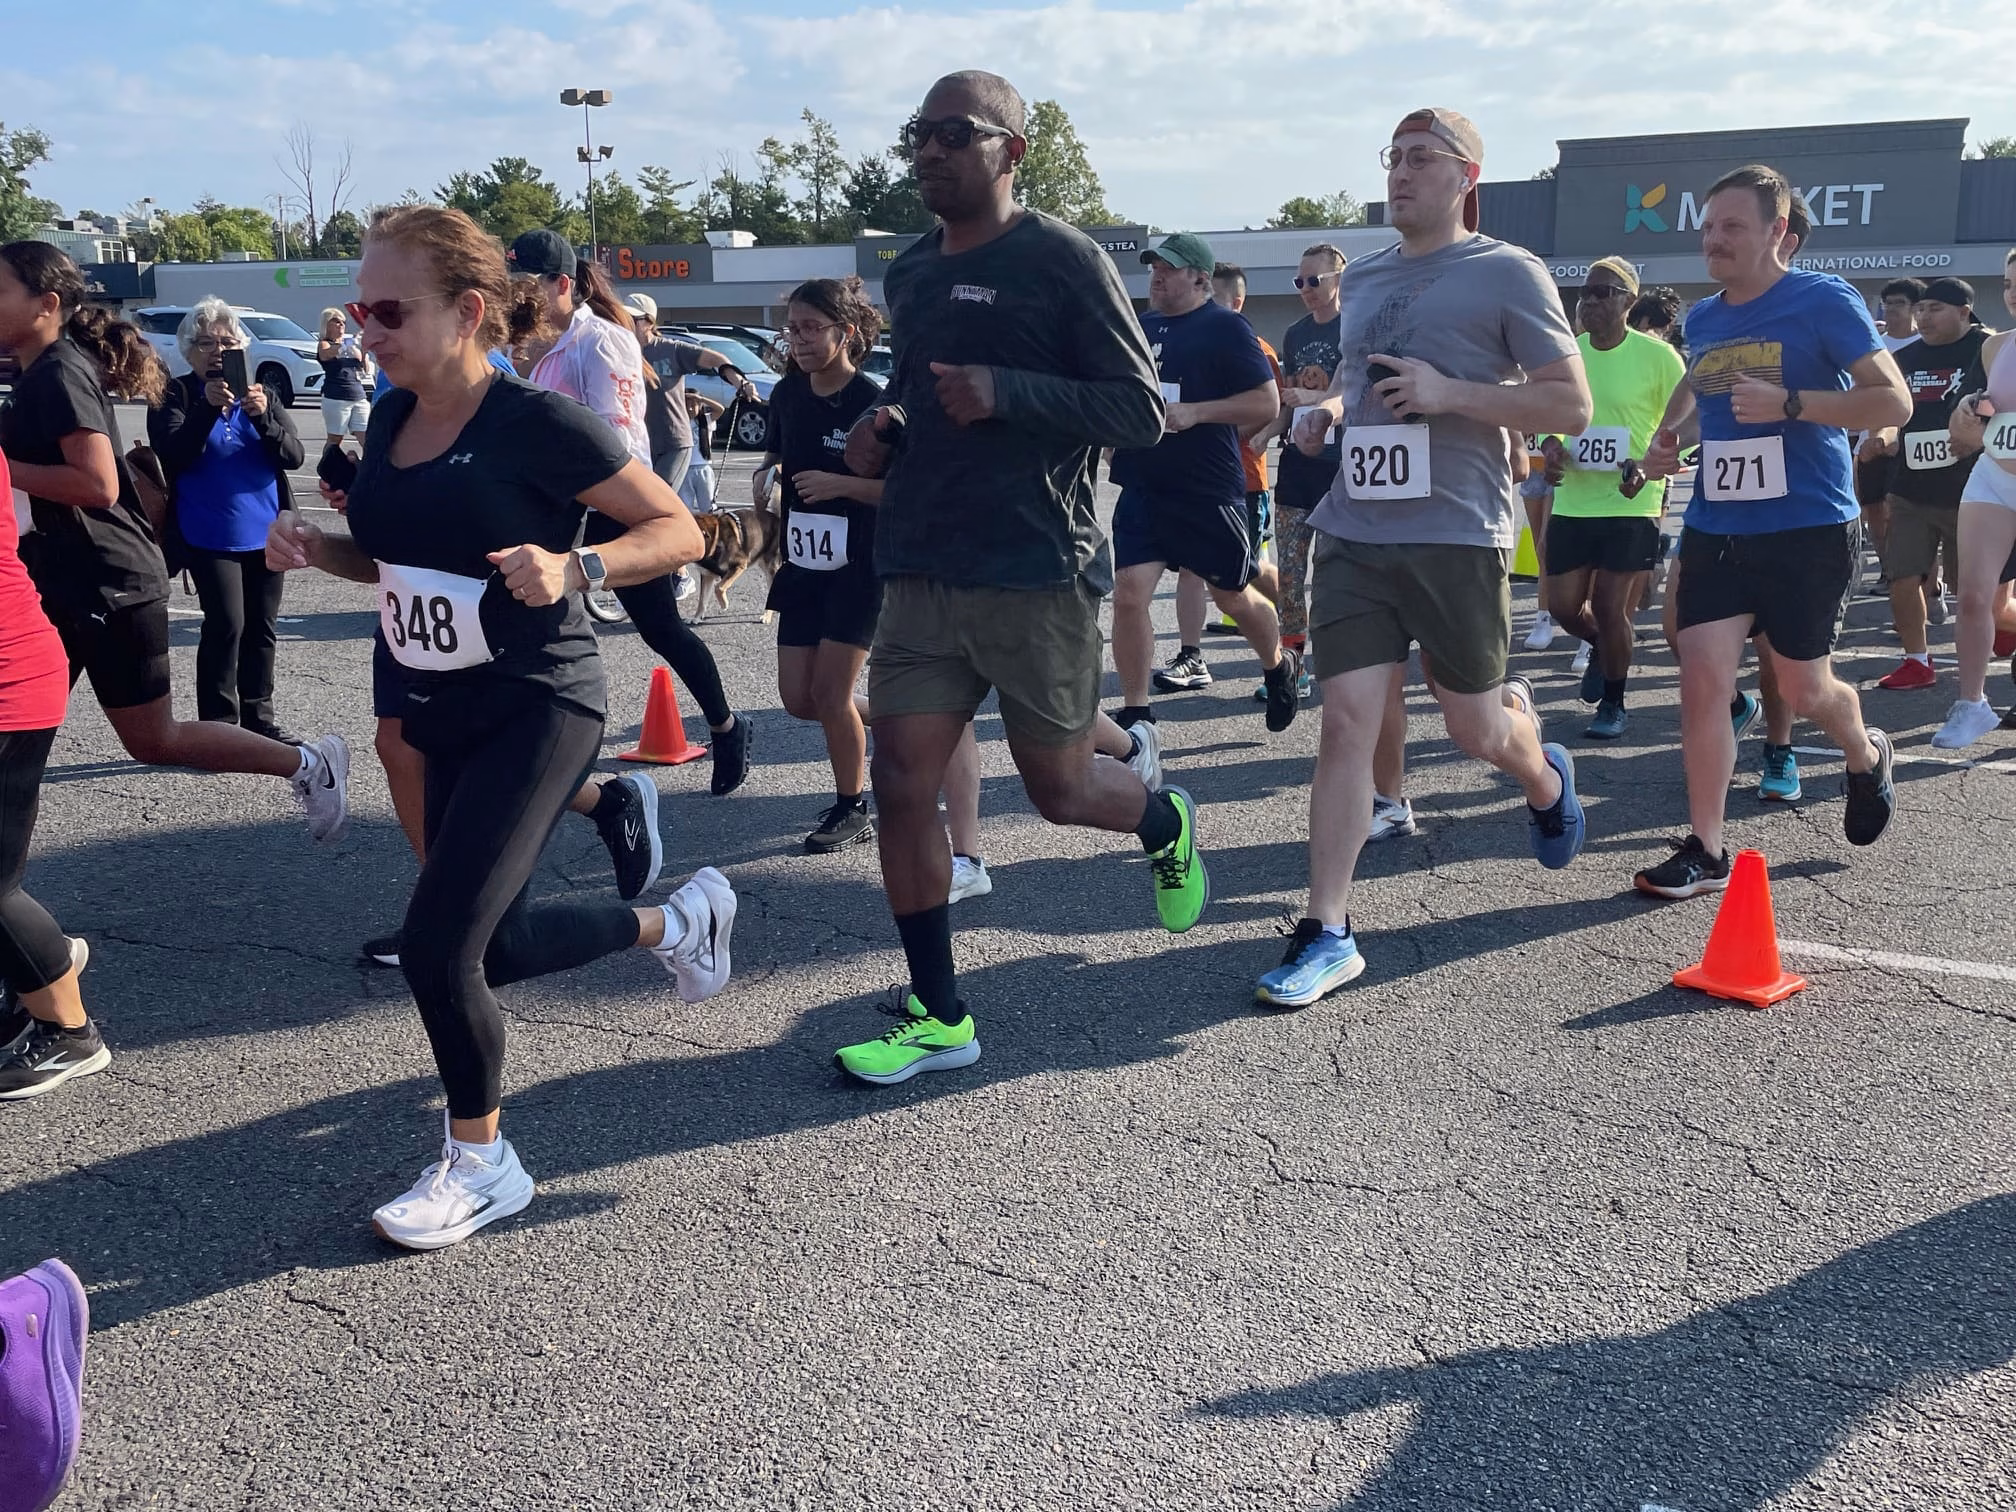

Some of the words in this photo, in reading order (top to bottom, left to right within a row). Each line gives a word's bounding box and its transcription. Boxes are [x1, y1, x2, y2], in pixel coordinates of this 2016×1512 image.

[1677, 183, 1885, 232] MKET
[618, 247, 689, 279] Store
[1792, 256, 1897, 271] ERNATIONAL
[1902, 254, 1952, 268] FOOD
[1350, 444, 1410, 488] 320
[1578, 438, 1616, 464] 265
[1715, 454, 1765, 491] 271
[791, 526, 834, 562] 314
[386, 590, 459, 654] 348
